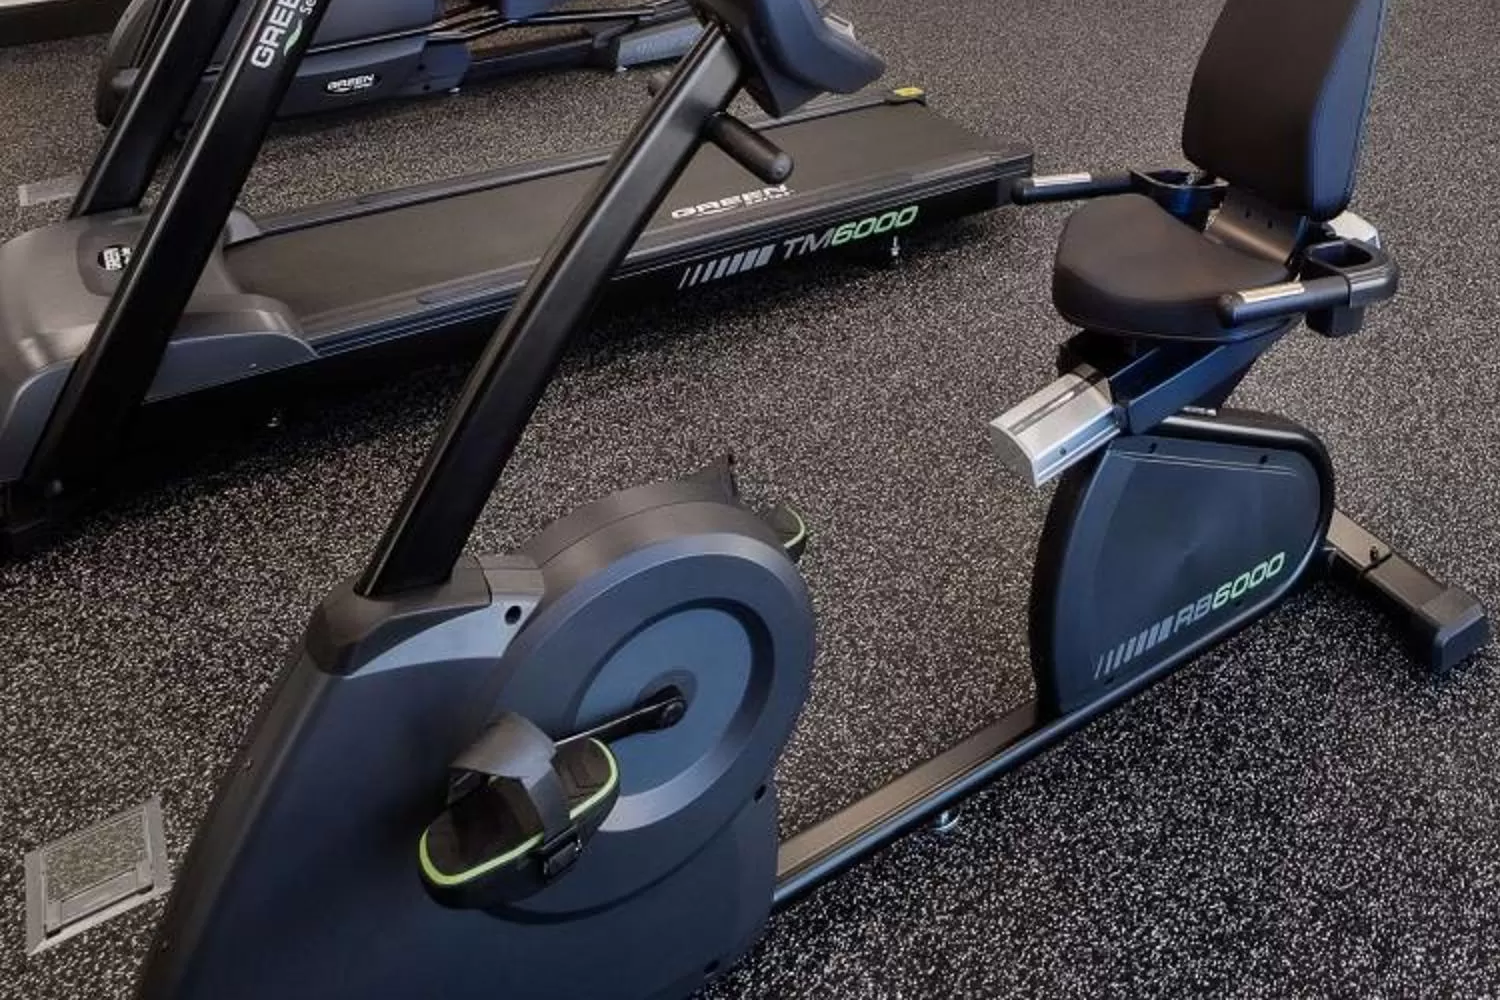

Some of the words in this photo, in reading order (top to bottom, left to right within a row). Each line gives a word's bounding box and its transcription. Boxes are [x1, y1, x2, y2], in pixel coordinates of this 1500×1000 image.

[327, 74, 375, 91] GREEN
[671, 185, 789, 218] GREEN
[783, 205, 919, 260] TM6000
[1173, 552, 1285, 633] RB6000
